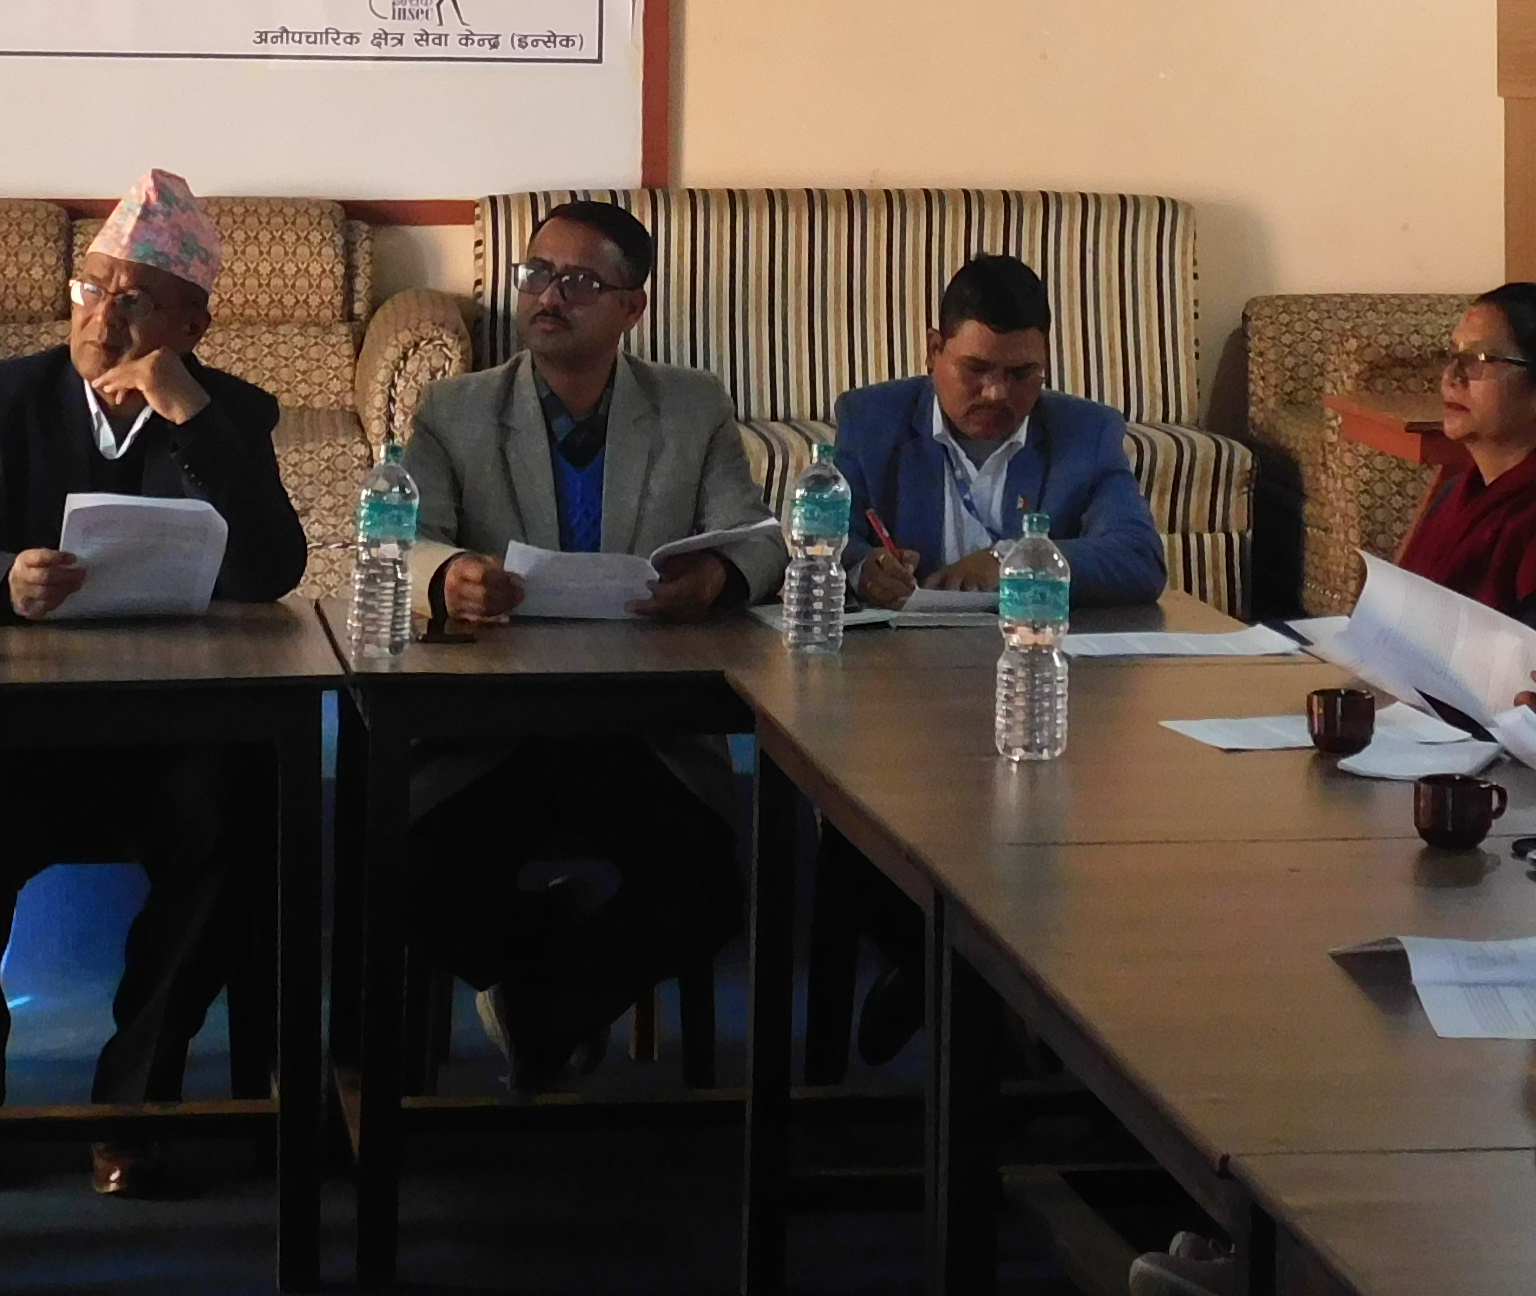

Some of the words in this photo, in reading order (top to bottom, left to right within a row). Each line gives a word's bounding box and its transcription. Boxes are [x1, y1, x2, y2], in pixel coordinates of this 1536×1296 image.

[252, 25, 363, 47] अनौपचारिक
[370, 27, 406, 50] क्षेत्र
[412, 28, 450, 48] सेवा
[457, 28, 503, 51] केन्द्र
[510, 29, 584, 52] (इन्सेक)
